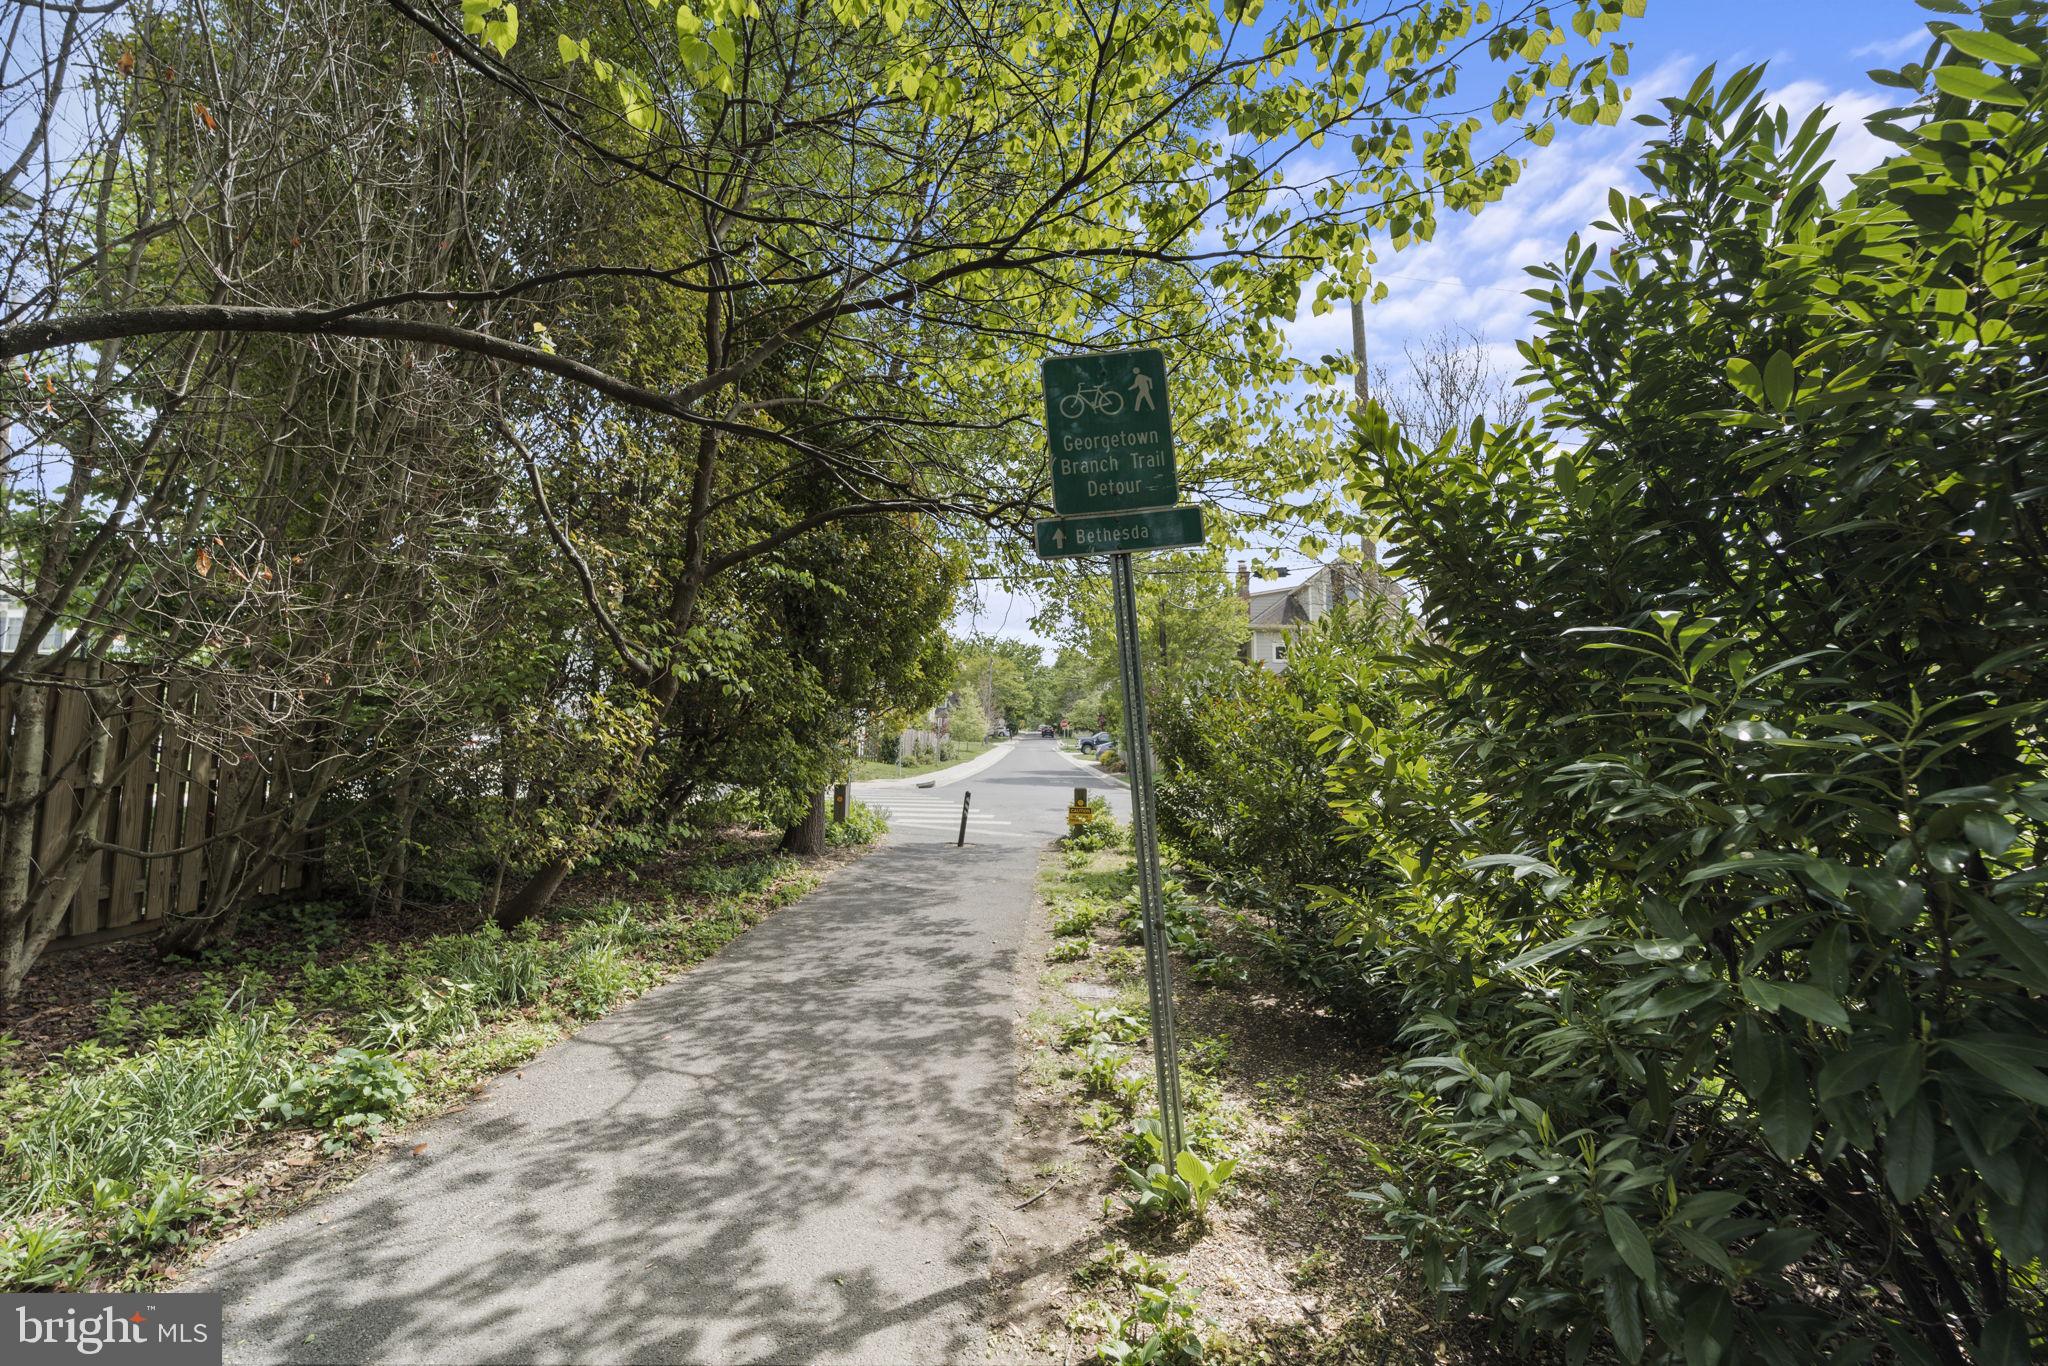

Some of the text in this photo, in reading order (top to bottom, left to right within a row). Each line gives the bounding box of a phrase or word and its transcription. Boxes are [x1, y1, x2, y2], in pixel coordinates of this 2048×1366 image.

[1063, 430, 1159, 452] Georgetown
[1061, 451, 1165, 475] Branch Trail
[1087, 479, 1142, 497] Detour
[1076, 525, 1149, 544] Bethesda
